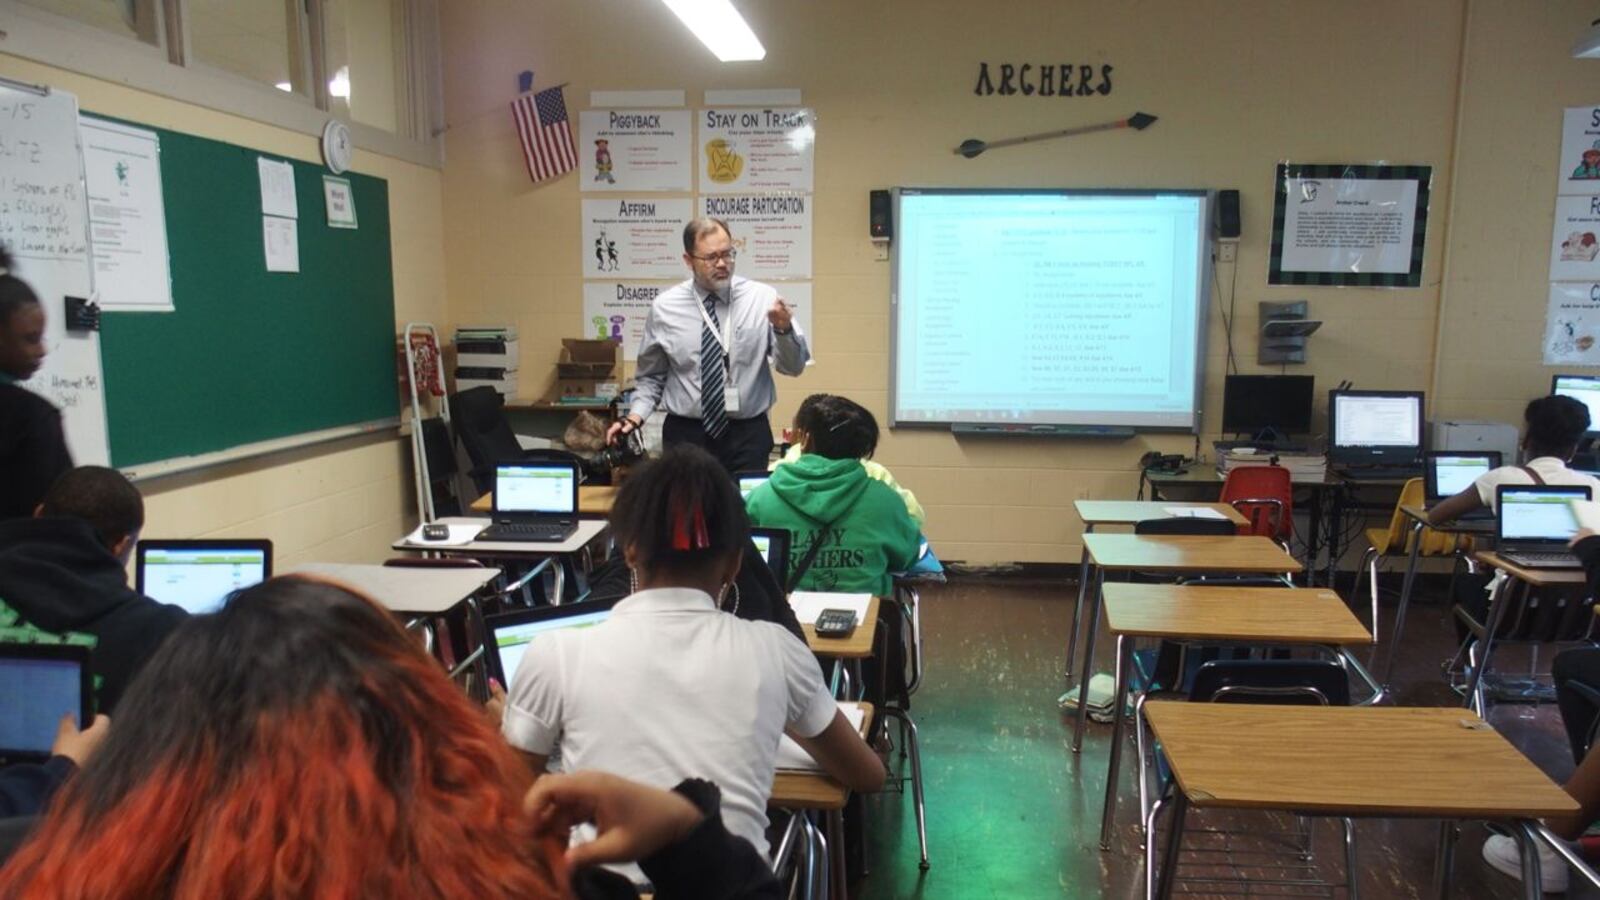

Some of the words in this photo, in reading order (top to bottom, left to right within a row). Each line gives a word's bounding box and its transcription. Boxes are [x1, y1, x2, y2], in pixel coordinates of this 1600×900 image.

[974, 62, 1114, 97] ARCHERS
[610, 111, 661, 129] PIGGYBACK
[707, 110, 737, 129] STAY
[741, 113, 759, 128] ON
[763, 109, 805, 128] TRACK
[619, 199, 656, 217] AFFIRM
[706, 197, 750, 215] ENCOURAGE
[752, 197, 805, 215] PARTICIPATION
